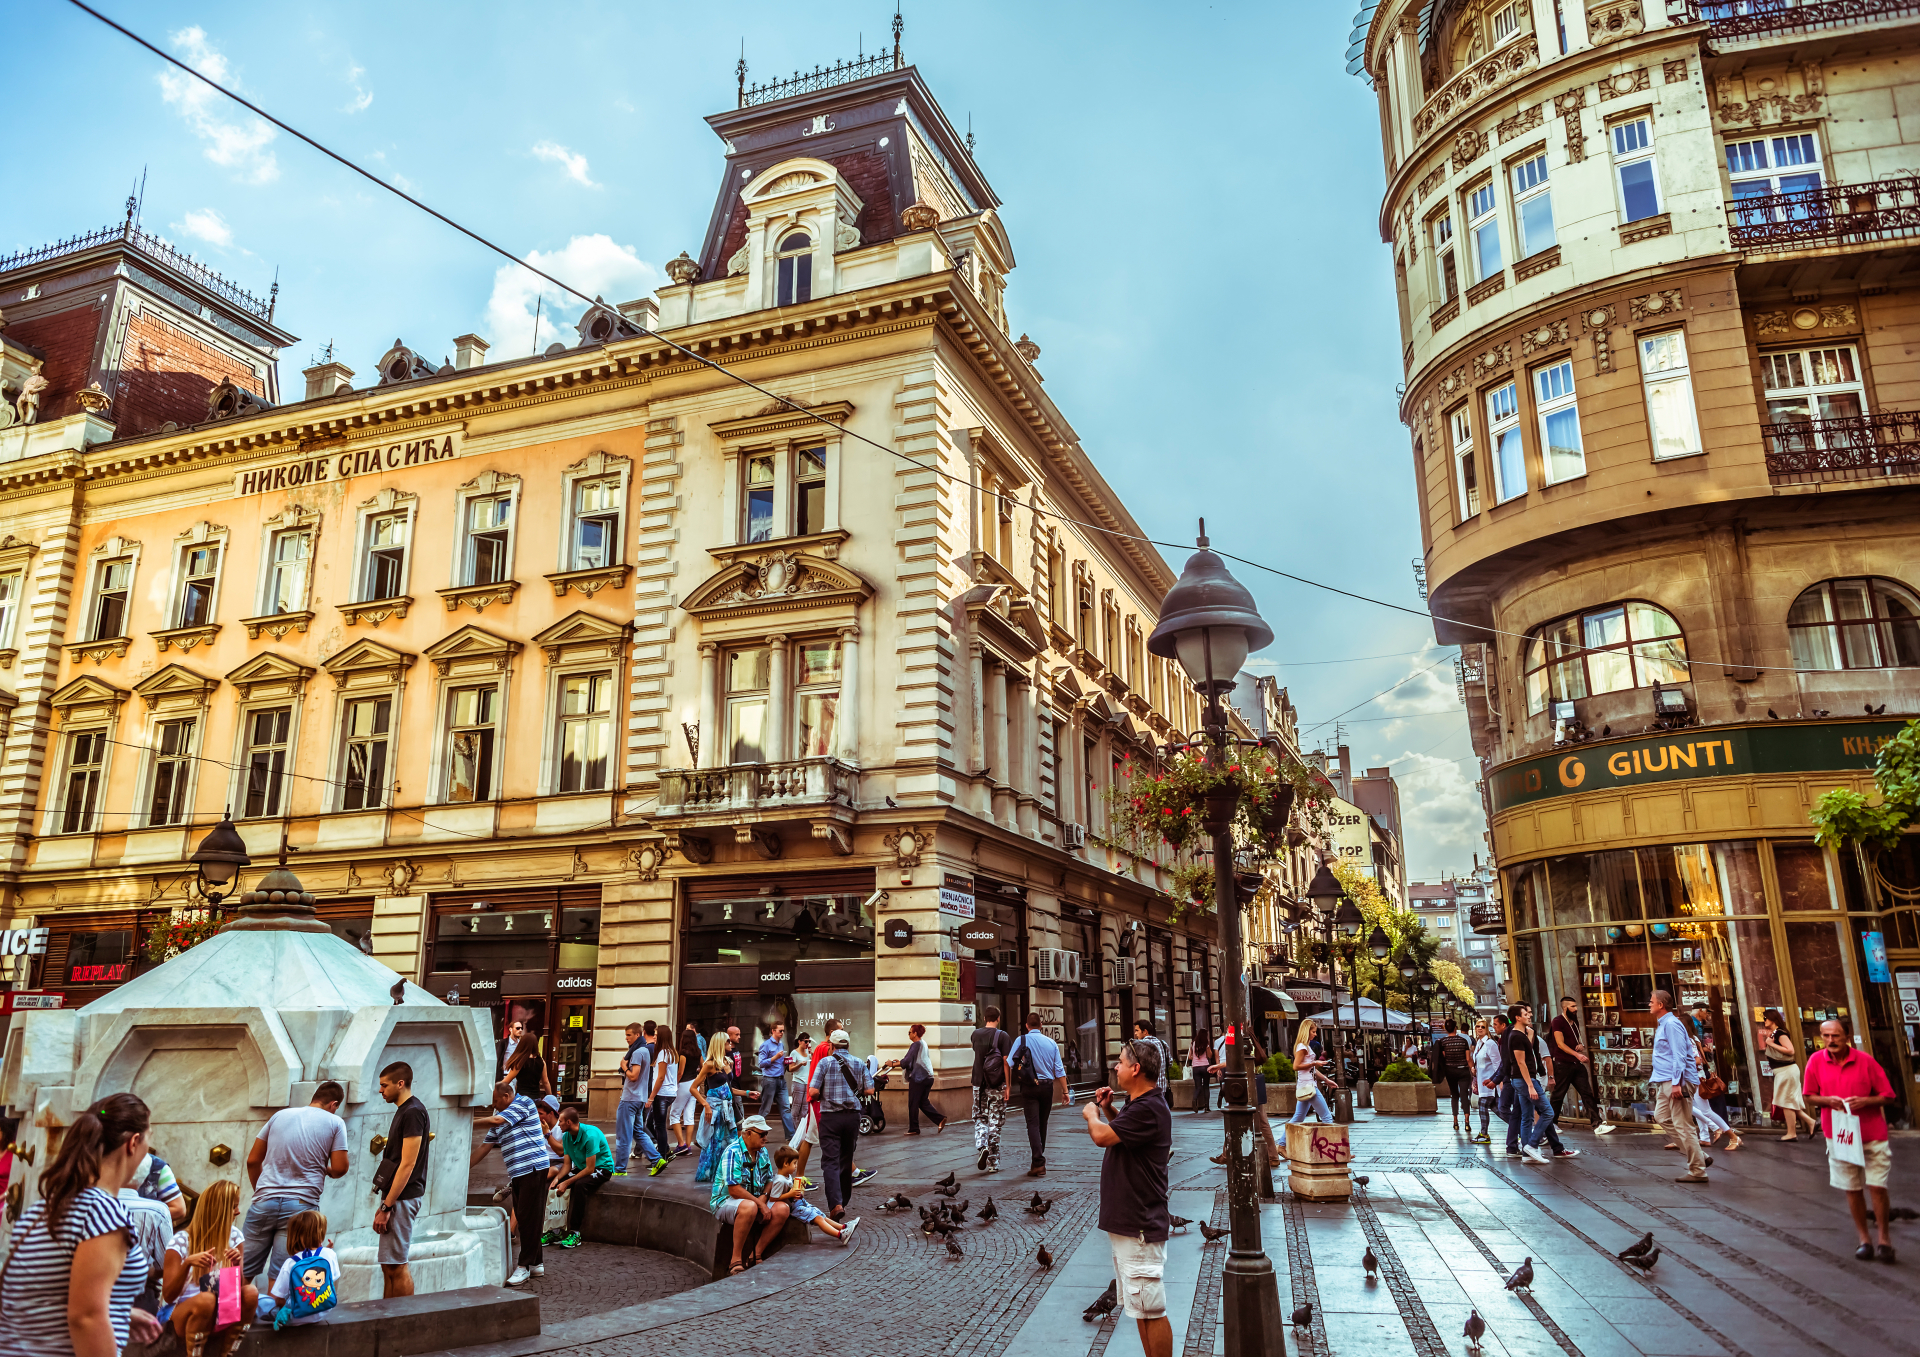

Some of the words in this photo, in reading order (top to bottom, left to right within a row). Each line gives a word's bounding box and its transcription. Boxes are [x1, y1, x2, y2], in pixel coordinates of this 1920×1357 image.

[241, 458, 329, 495] НИКОЛЕ
[338, 435, 454, 477] СПАСИЋА
[1608, 740, 1734, 776] GIUNTI
[941, 891, 973, 905] MENJAČNICA
[893, 930, 908, 938] adidas
[966, 932, 994, 940] adidas
[0, 928, 49, 955] ICE
[71, 965, 126, 981] REPLAY
[761, 972, 791, 981] adidas
[471, 980, 497, 990] adidas
[557, 977, 593, 988] adidas
[800, 1019, 852, 1027] EVERYNG
